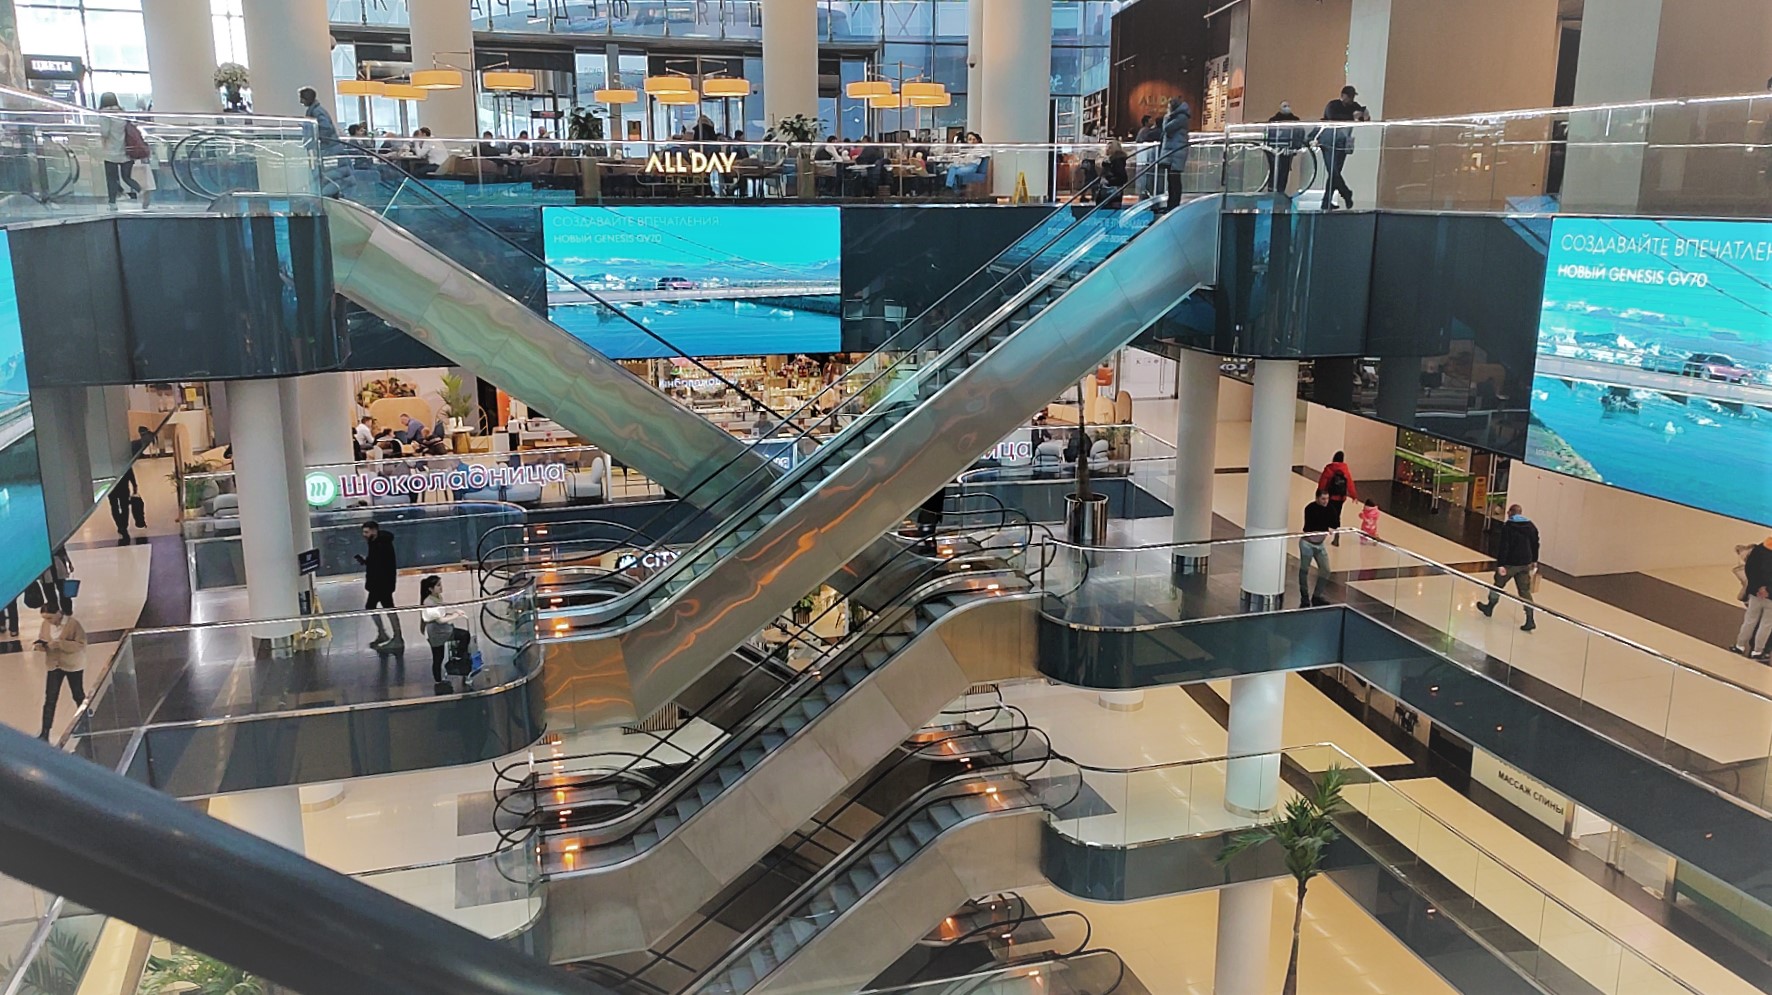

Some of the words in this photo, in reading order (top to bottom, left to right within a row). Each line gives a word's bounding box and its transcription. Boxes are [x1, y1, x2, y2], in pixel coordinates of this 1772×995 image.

[31, 60, 74, 72] ЦВЕТЫ
[644, 151, 686, 173] ALL
[690, 151, 737, 173] DAY
[552, 215, 634, 228] СОЗДАВАЙТЕ
[637, 215, 720, 227] ВПЕЧАТЛЕНИЯ
[553, 232, 592, 243] НОВЫЙ
[593, 233, 635, 244] GENESIS
[636, 233, 662, 243] GV70
[1561, 233, 1671, 256] СОЗДАВАЙТЕ
[1557, 263, 1606, 281] НОВЫЙ
[1609, 267, 1665, 286] GENESIS
[1668, 271, 1708, 288] GV70
[981, 440, 1032, 461] ица
[338, 462, 568, 498] Шоколадница
[1498, 770, 1531, 797] МАССАЖ
[1533, 791, 1564, 816] СПИНЫ
